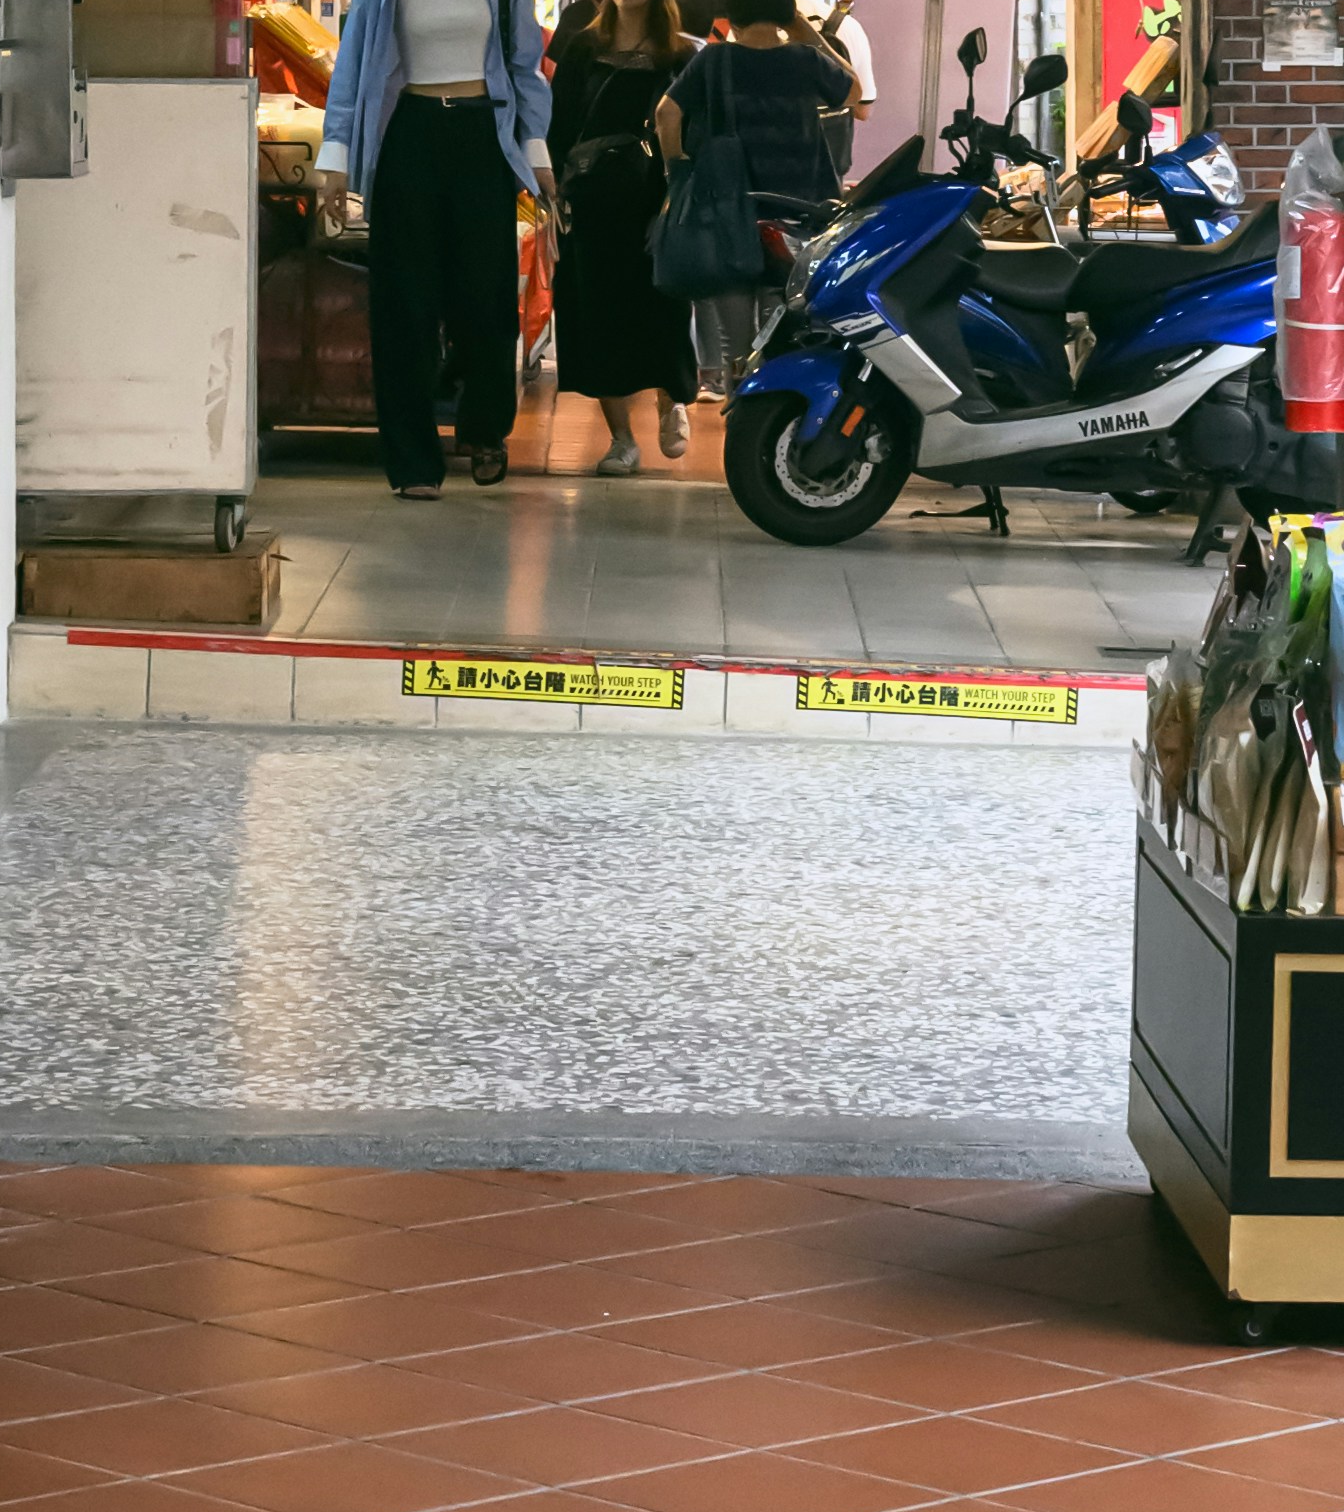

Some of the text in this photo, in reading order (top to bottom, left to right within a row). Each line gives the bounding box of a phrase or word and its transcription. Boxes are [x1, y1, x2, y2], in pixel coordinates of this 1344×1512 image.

[1078, 410, 1151, 438] YAMAHA
[457, 665, 662, 693] 請小心台階 WATCH YOUR STEP
[851, 680, 1056, 707] 請小心台階 WATCH YOUR STEP
